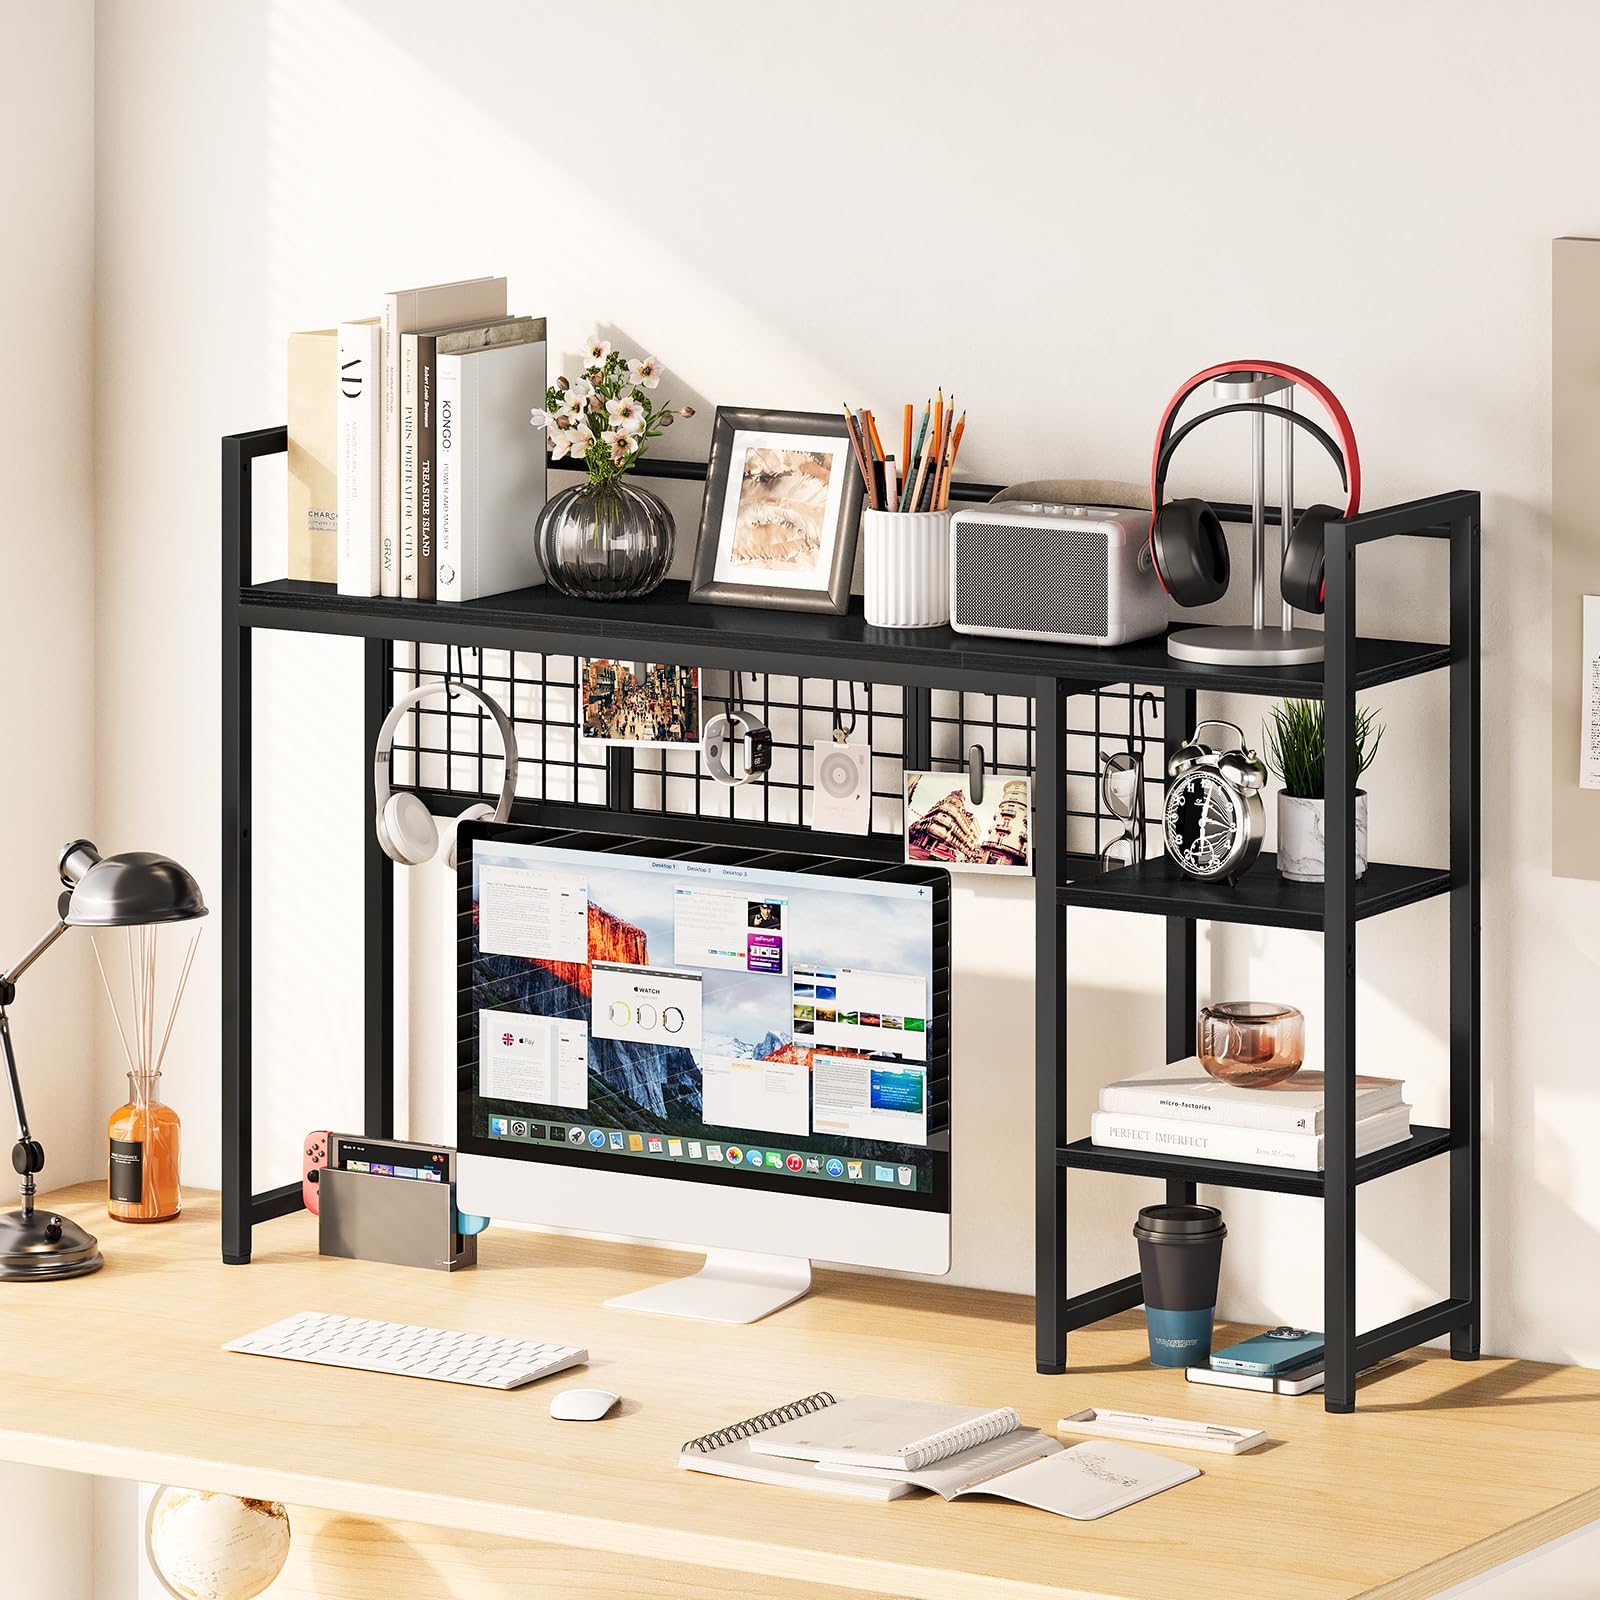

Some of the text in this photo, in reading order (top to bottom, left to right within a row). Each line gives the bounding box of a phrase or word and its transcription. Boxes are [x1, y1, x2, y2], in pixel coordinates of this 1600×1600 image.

[442, 400, 452, 551] KONGO: POWER AND MAJESTY
[404, 505, 413, 520] OF
[422, 459, 430, 557] TREASURE ISLAND
[308, 510, 338, 521] CHARC
[384, 538, 393, 572] GRAY
[651, 862, 672, 870] Desktop
[639, 987, 660, 995] WATCH
[524, 1037, 535, 1047] Pay
[1159, 1099, 1212, 1111] micro-factories
[1109, 1126, 1209, 1148] PERFECT IMPERFECT
[651, 1142, 660, 1151] 18
